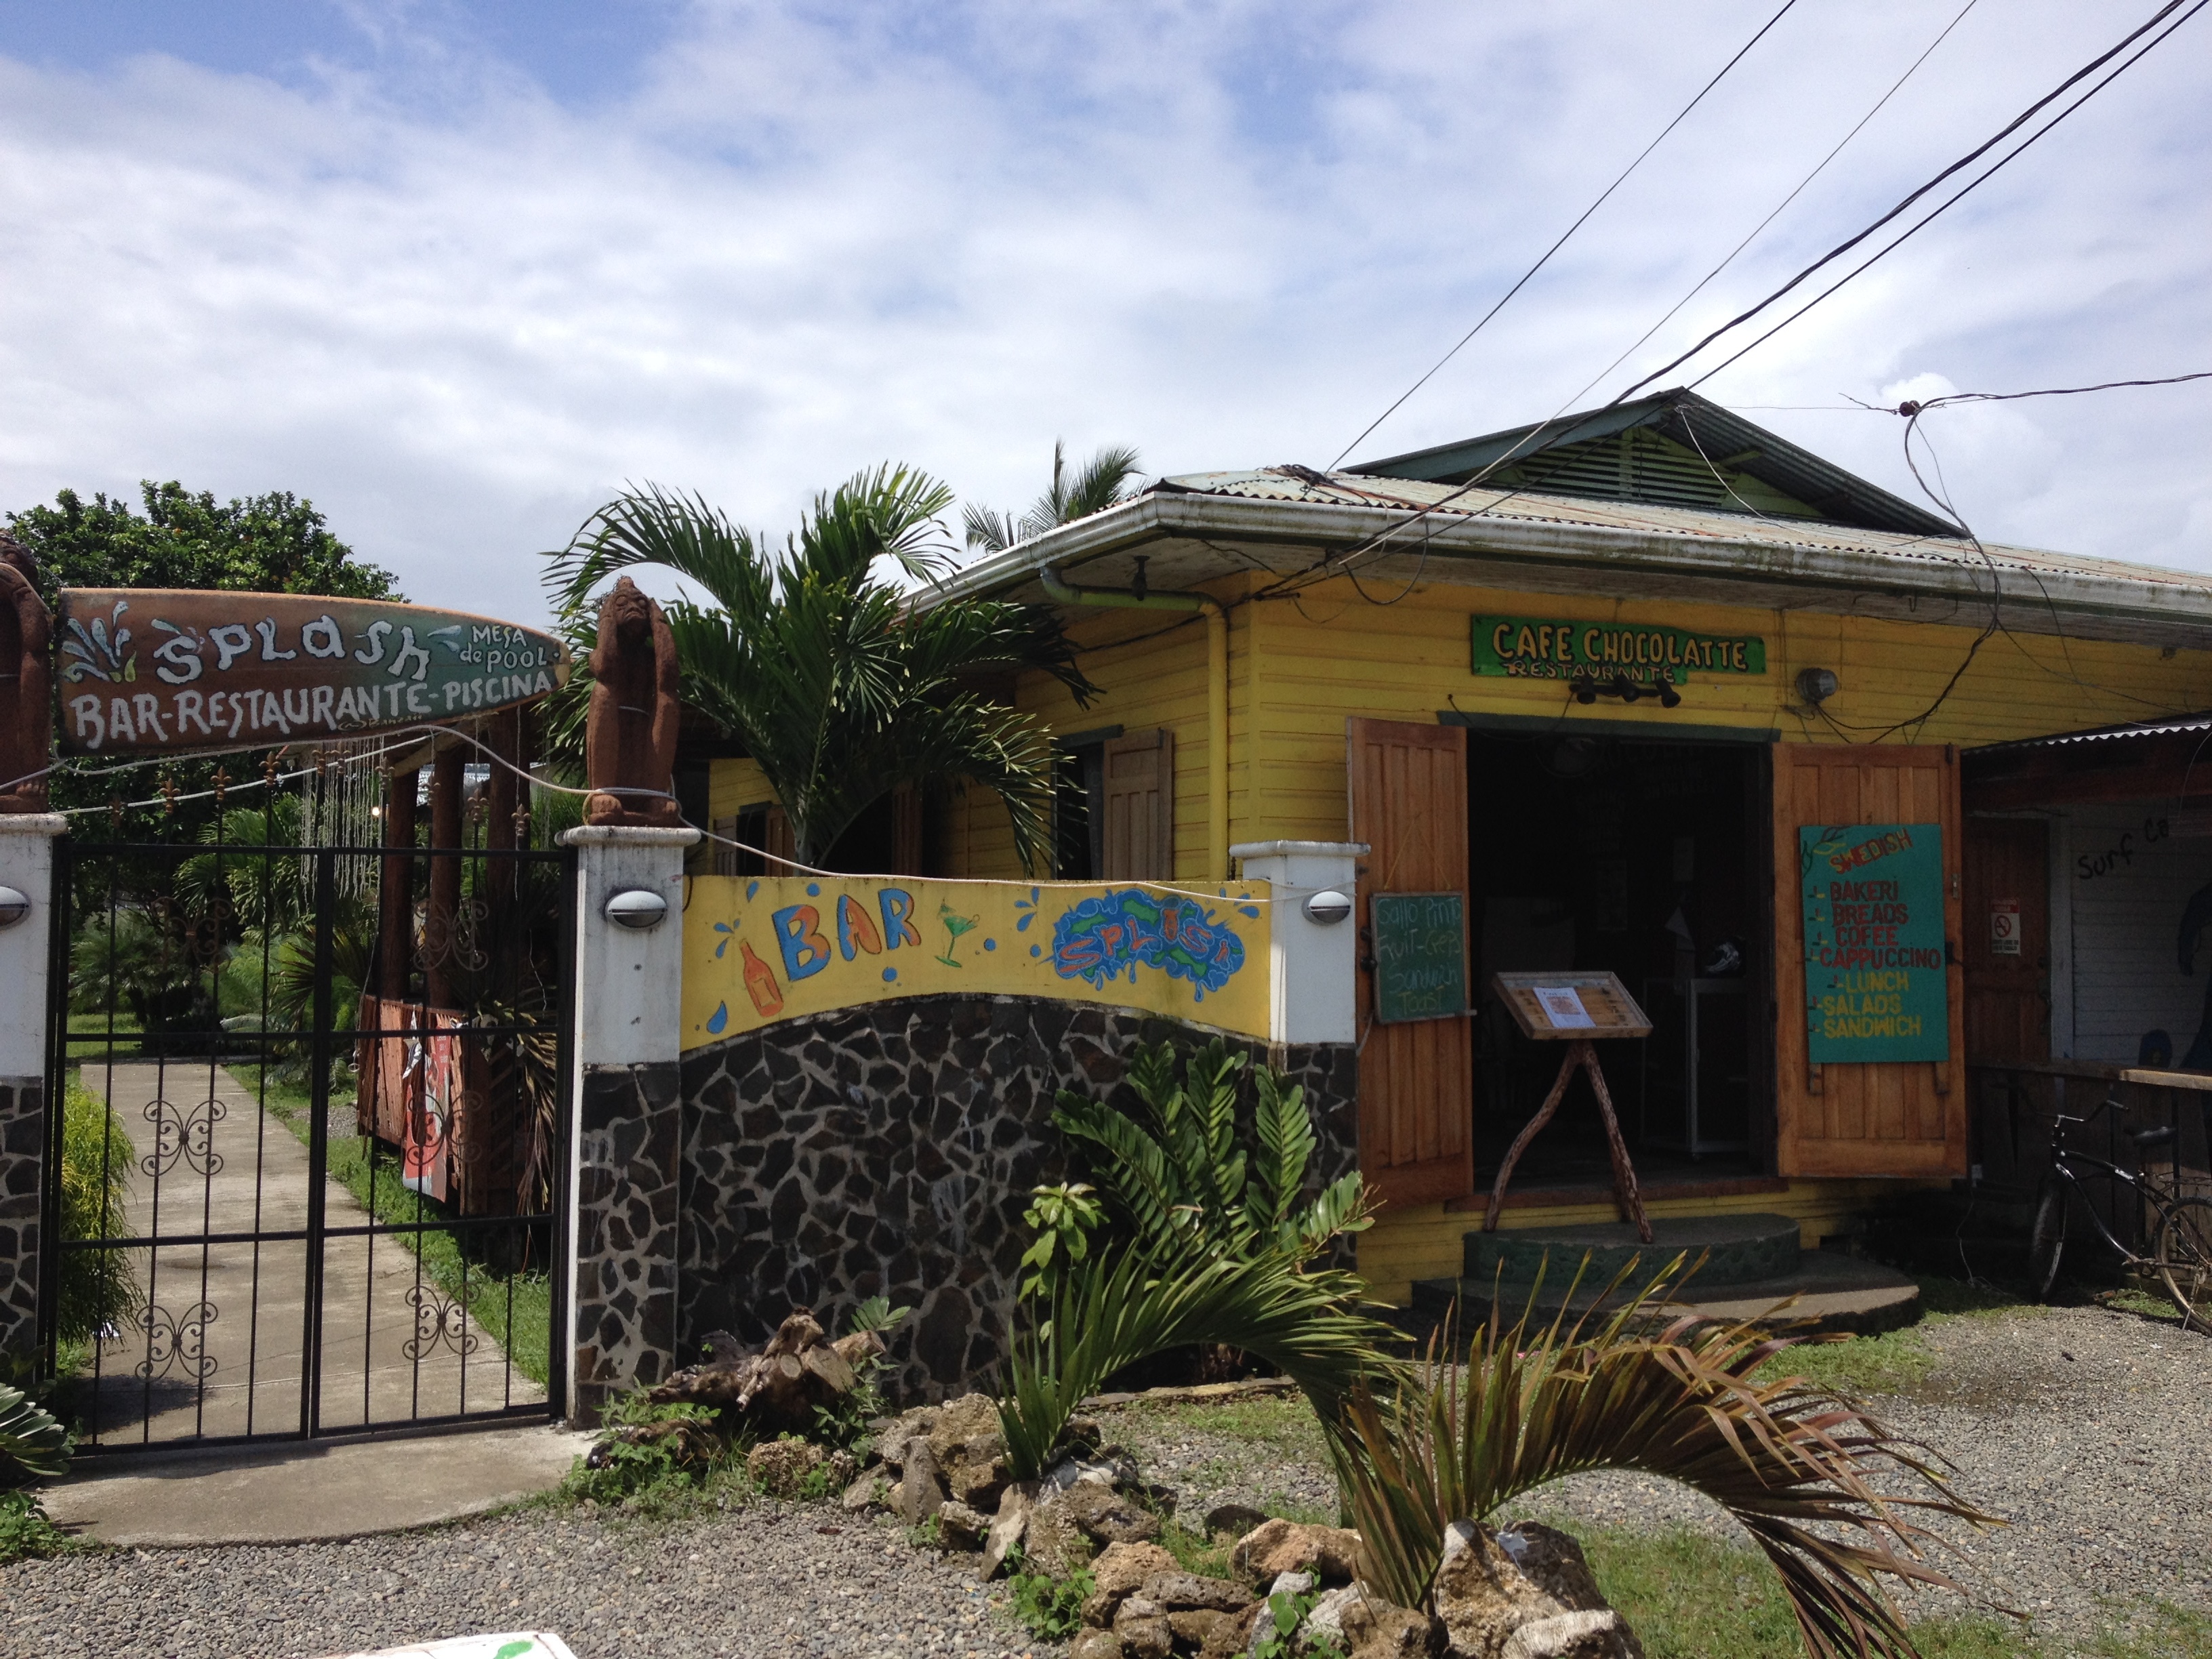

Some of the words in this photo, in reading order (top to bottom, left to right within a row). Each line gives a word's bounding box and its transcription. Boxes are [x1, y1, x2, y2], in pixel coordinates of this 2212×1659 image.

[472, 624, 527, 649] MESA
[1493, 623, 1574, 661] CAFE
[1583, 628, 1747, 670] CHOCOLATTE
[459, 642, 483, 663] de
[487, 646, 548, 674] POOL
[1829, 827, 1914, 874] SWEDISH
[2077, 833, 2133, 880] Surf
[1832, 903, 1909, 927] BREADS
[771, 887, 922, 982] BAR
[1836, 926, 1899, 947] COFEE
[1820, 947, 1942, 970] CAPPUCCINO
[1845, 970, 1910, 994] LUNCH
[1822, 994, 1903, 1017] SALADS
[1823, 1015, 1922, 1039] SANDWICH
